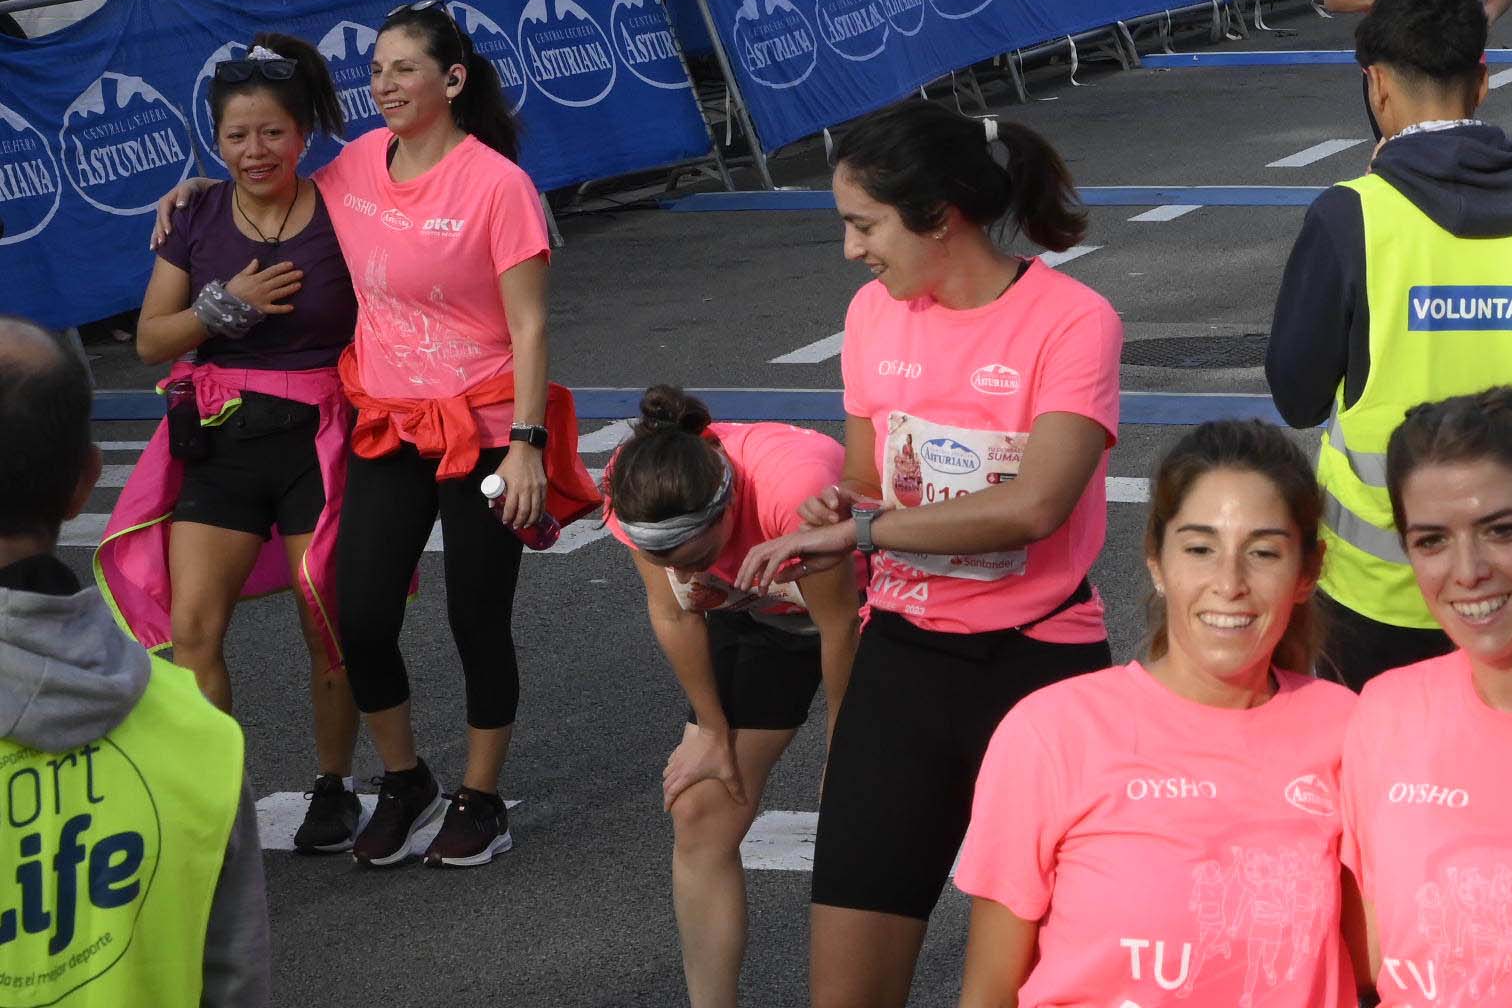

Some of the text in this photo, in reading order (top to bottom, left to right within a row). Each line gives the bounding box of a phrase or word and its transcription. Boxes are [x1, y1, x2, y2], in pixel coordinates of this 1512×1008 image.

[527, 37, 612, 81] ASTURIANA
[620, 22, 682, 65] ASTUR
[335, 64, 366, 82] ENTRAL
[72, 127, 186, 187] ASTURIANA
[344, 193, 377, 217] OYSHO
[422, 218, 465, 232] DKV
[8, 744, 105, 828] ort
[1127, 778, 1216, 800] OYSHO
[1389, 782, 1469, 808] OYSHO
[0, 813, 144, 956] ife
[1120, 938, 1191, 990] TU
[1384, 958, 1437, 1001] TU
